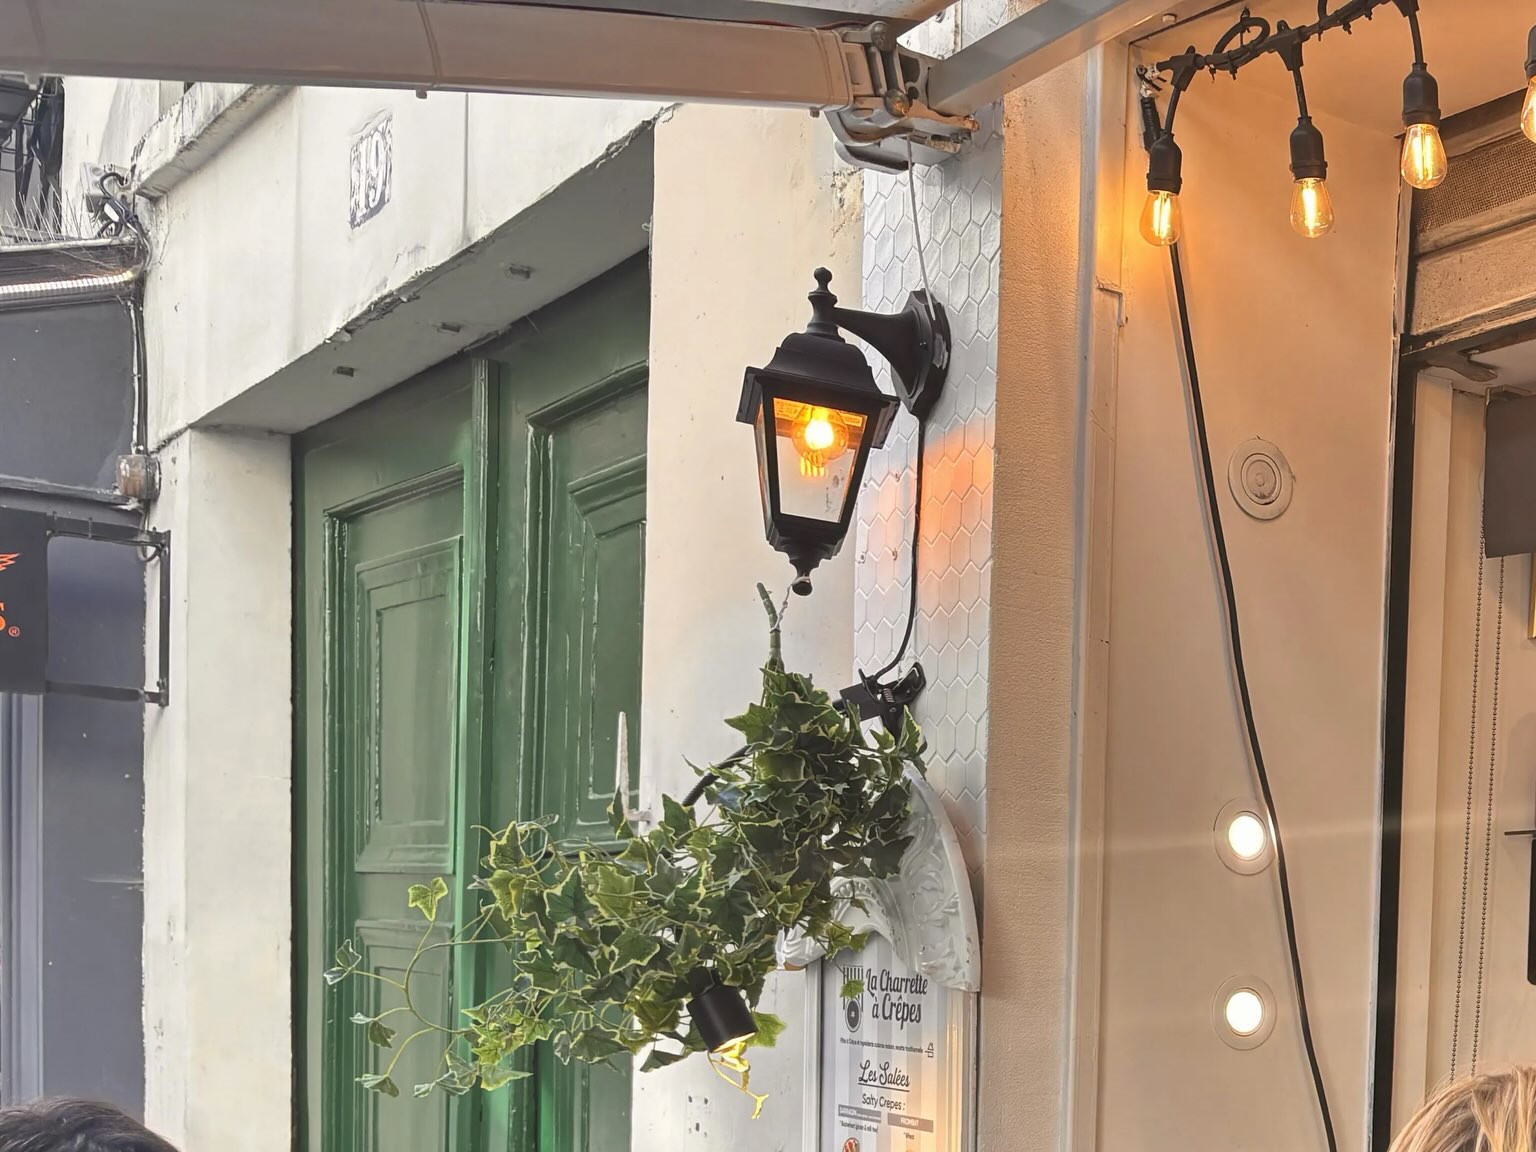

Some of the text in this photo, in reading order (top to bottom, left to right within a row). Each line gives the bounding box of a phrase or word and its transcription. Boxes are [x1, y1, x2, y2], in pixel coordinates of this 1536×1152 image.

[866, 968, 928, 997] La Charrette
[872, 993, 921, 1030] à Crêpes
[859, 1060, 910, 1087] Les Salées
[862, 1094, 878, 1108] Salty
[879, 1096, 901, 1111] Crepes
